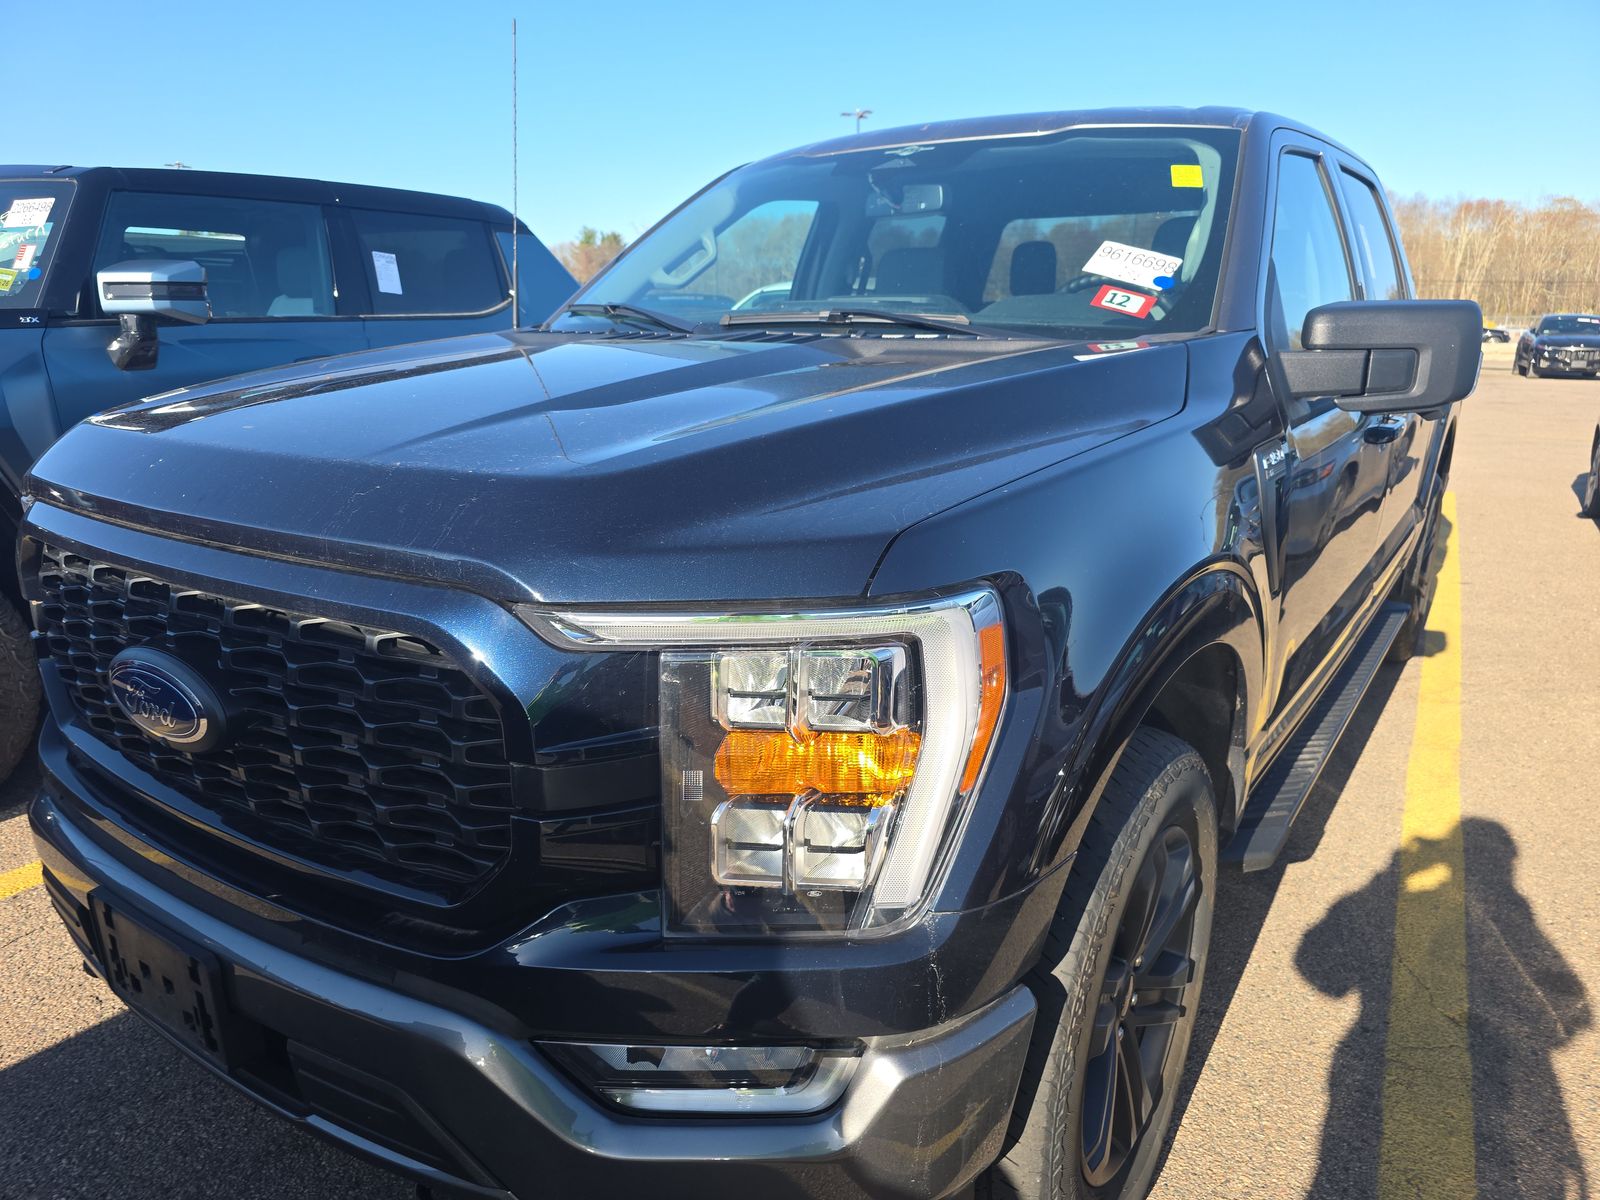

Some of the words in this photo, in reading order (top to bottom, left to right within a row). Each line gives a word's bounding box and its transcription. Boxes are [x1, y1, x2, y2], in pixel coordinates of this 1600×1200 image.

[1099, 246, 1178, 274] 9616698
[1105, 292, 1131, 308] 12
[124, 676, 177, 728] Ford
